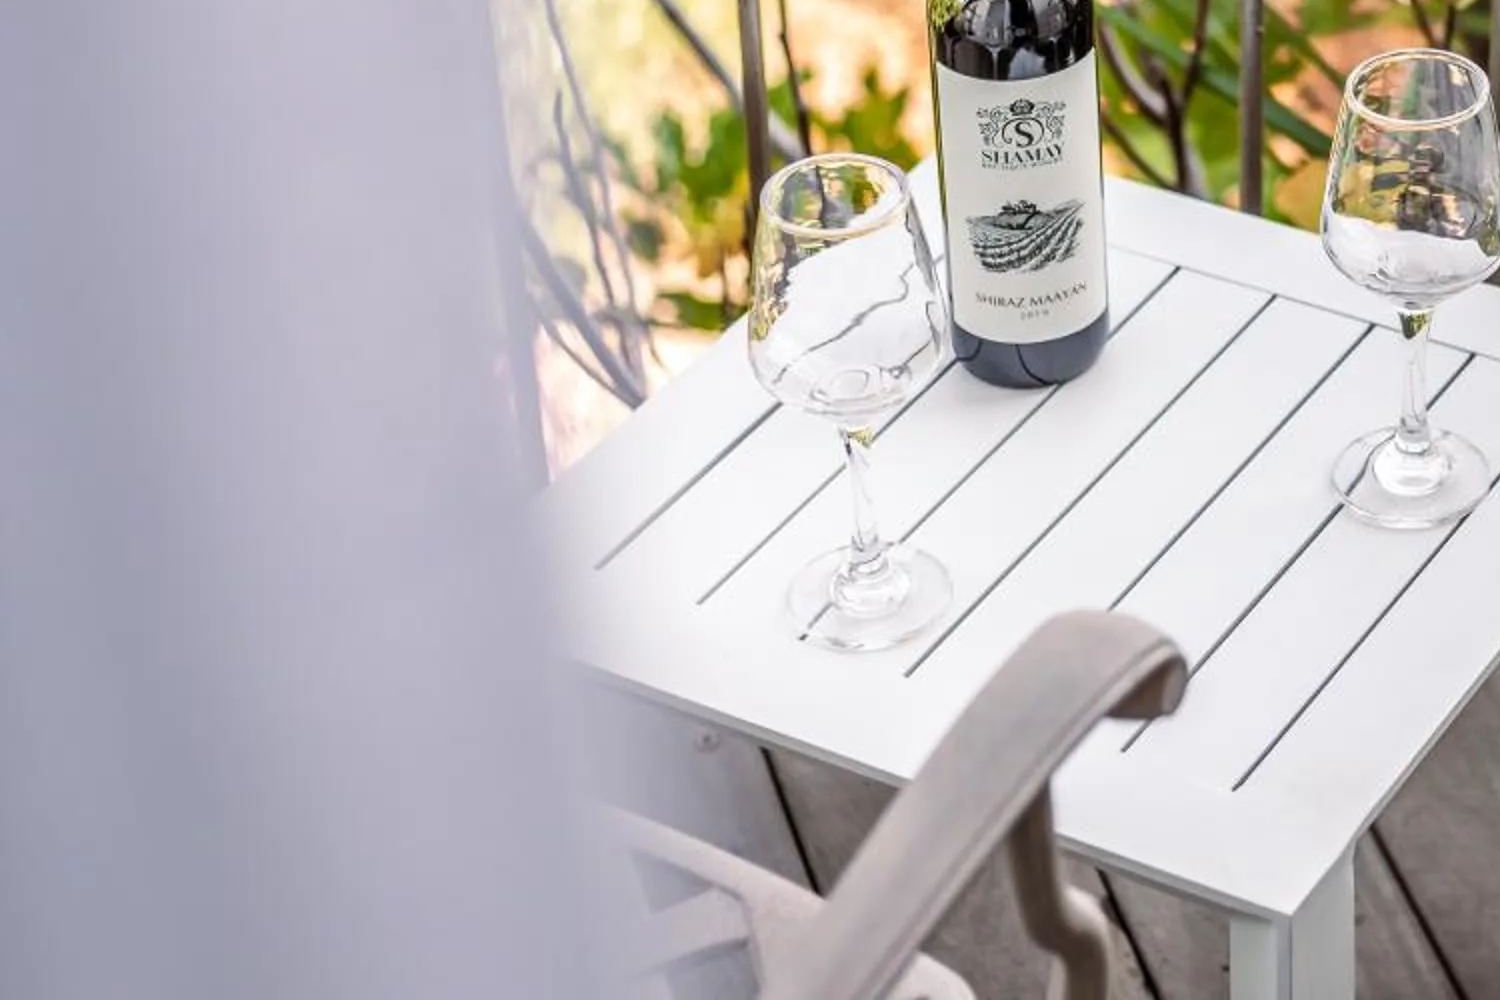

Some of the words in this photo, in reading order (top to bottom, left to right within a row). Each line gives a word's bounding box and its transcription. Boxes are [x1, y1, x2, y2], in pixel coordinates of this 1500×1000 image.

[1015, 120, 1034, 148] S
[981, 143, 1064, 165] SHAMAY
[975, 291, 1025, 309] SHIRAZ
[1029, 281, 1087, 307] MAAYAN
